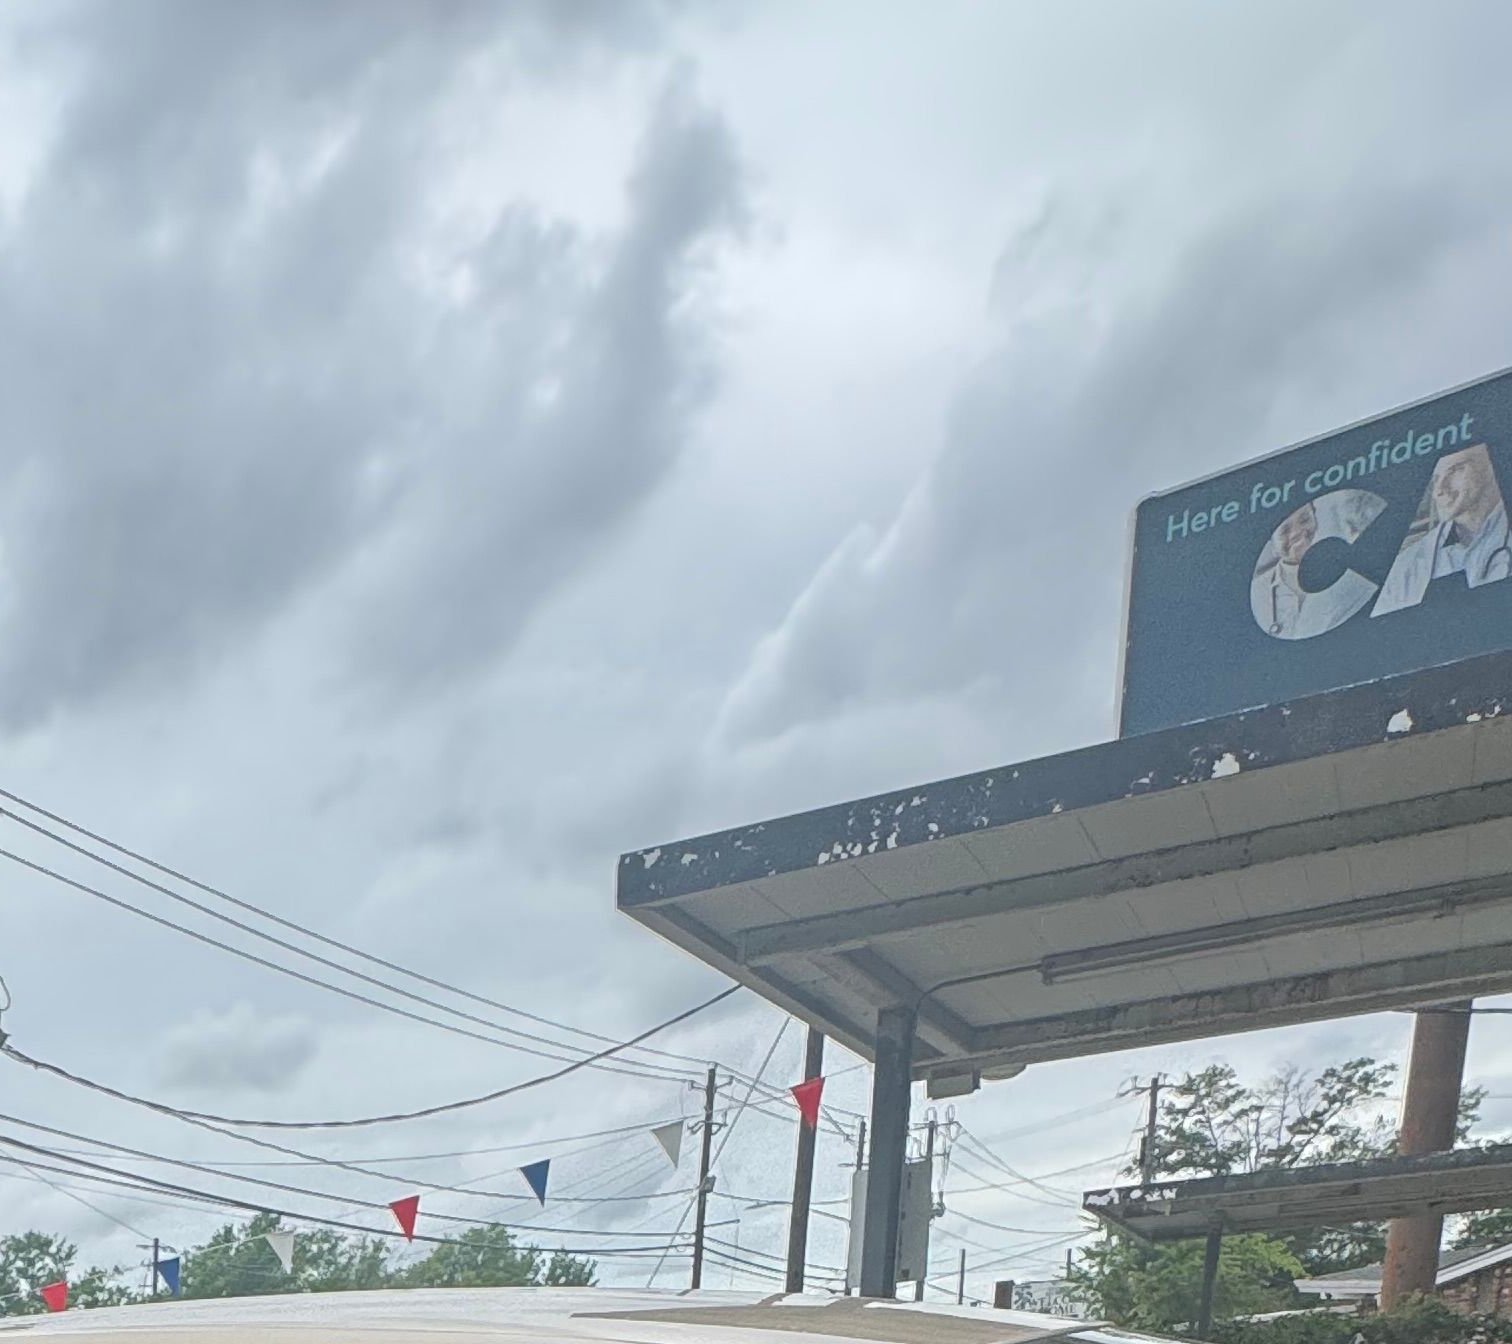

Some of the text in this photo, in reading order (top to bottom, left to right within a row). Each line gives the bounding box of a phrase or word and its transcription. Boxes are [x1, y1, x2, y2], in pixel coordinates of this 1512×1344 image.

[1166, 412, 1474, 542] Here for confident
